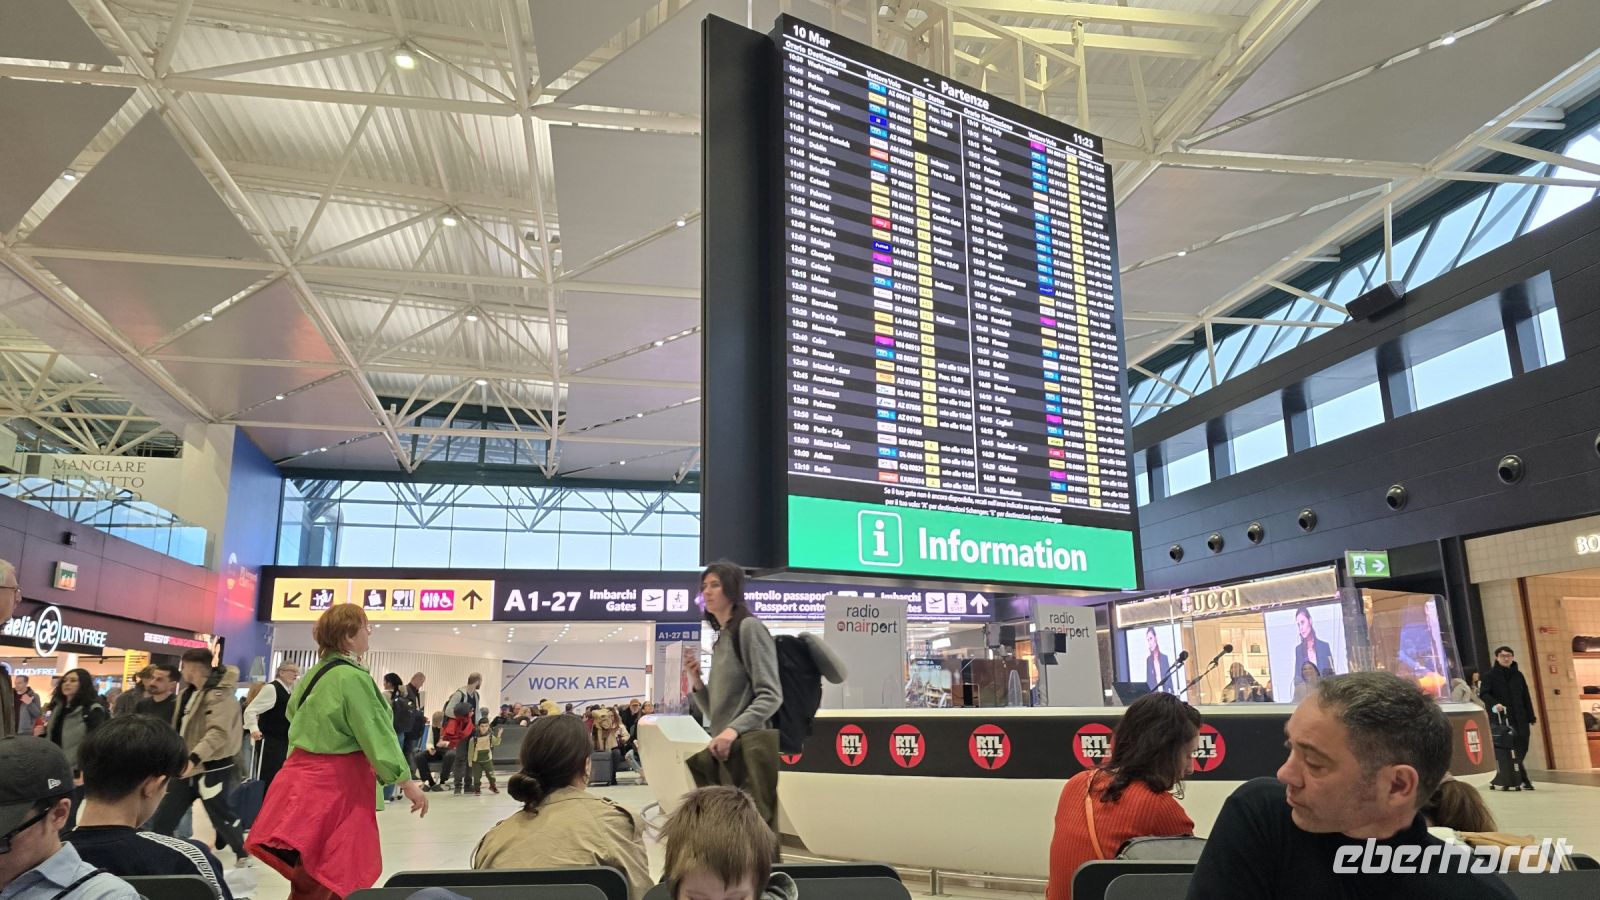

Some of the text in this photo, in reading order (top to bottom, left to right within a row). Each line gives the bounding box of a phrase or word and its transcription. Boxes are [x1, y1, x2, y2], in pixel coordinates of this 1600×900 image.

[793, 25, 830, 48] 10 Mar
[941, 80, 989, 110] Partenze
[1073, 133, 1094, 148] 11:23
[52, 459, 146, 473] MANGIARE
[919, 527, 1087, 571] Information
[504, 589, 636, 612] A1-27 Imbarchi
[744, 590, 833, 603] ontrollo passapor
[606, 601, 636, 612] Gates
[755, 602, 797, 613] Passport
[846, 604, 880, 618] radio
[907, 604, 922, 612] tes
[1050, 612, 1074, 624] radio
[4, 616, 36, 638] aelia
[529, 676, 629, 690] WORK AREA
[842, 735, 861, 746] RTL
[896, 736, 918, 748] RTL
[976, 736, 1003, 748] RTL
[1081, 736, 1110, 748] RTL
[896, 748, 919, 756] 102.5
[977, 749, 1003, 757] 102.5
